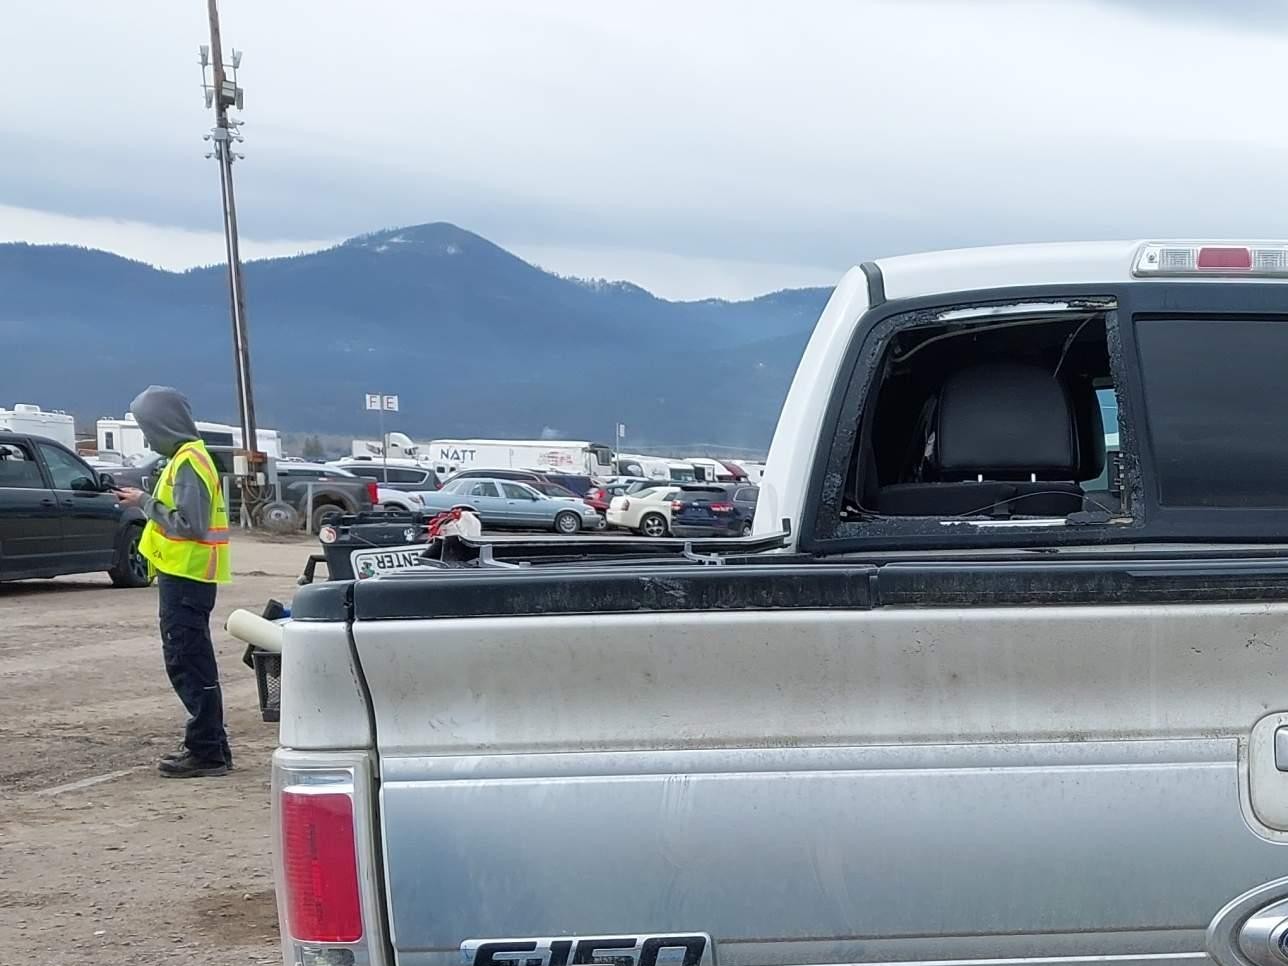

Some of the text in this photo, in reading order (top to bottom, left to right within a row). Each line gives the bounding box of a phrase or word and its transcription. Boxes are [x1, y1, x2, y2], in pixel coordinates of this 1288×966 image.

[369, 395, 377, 408] F
[386, 396, 395, 409] E
[440, 448, 477, 463] NATT
